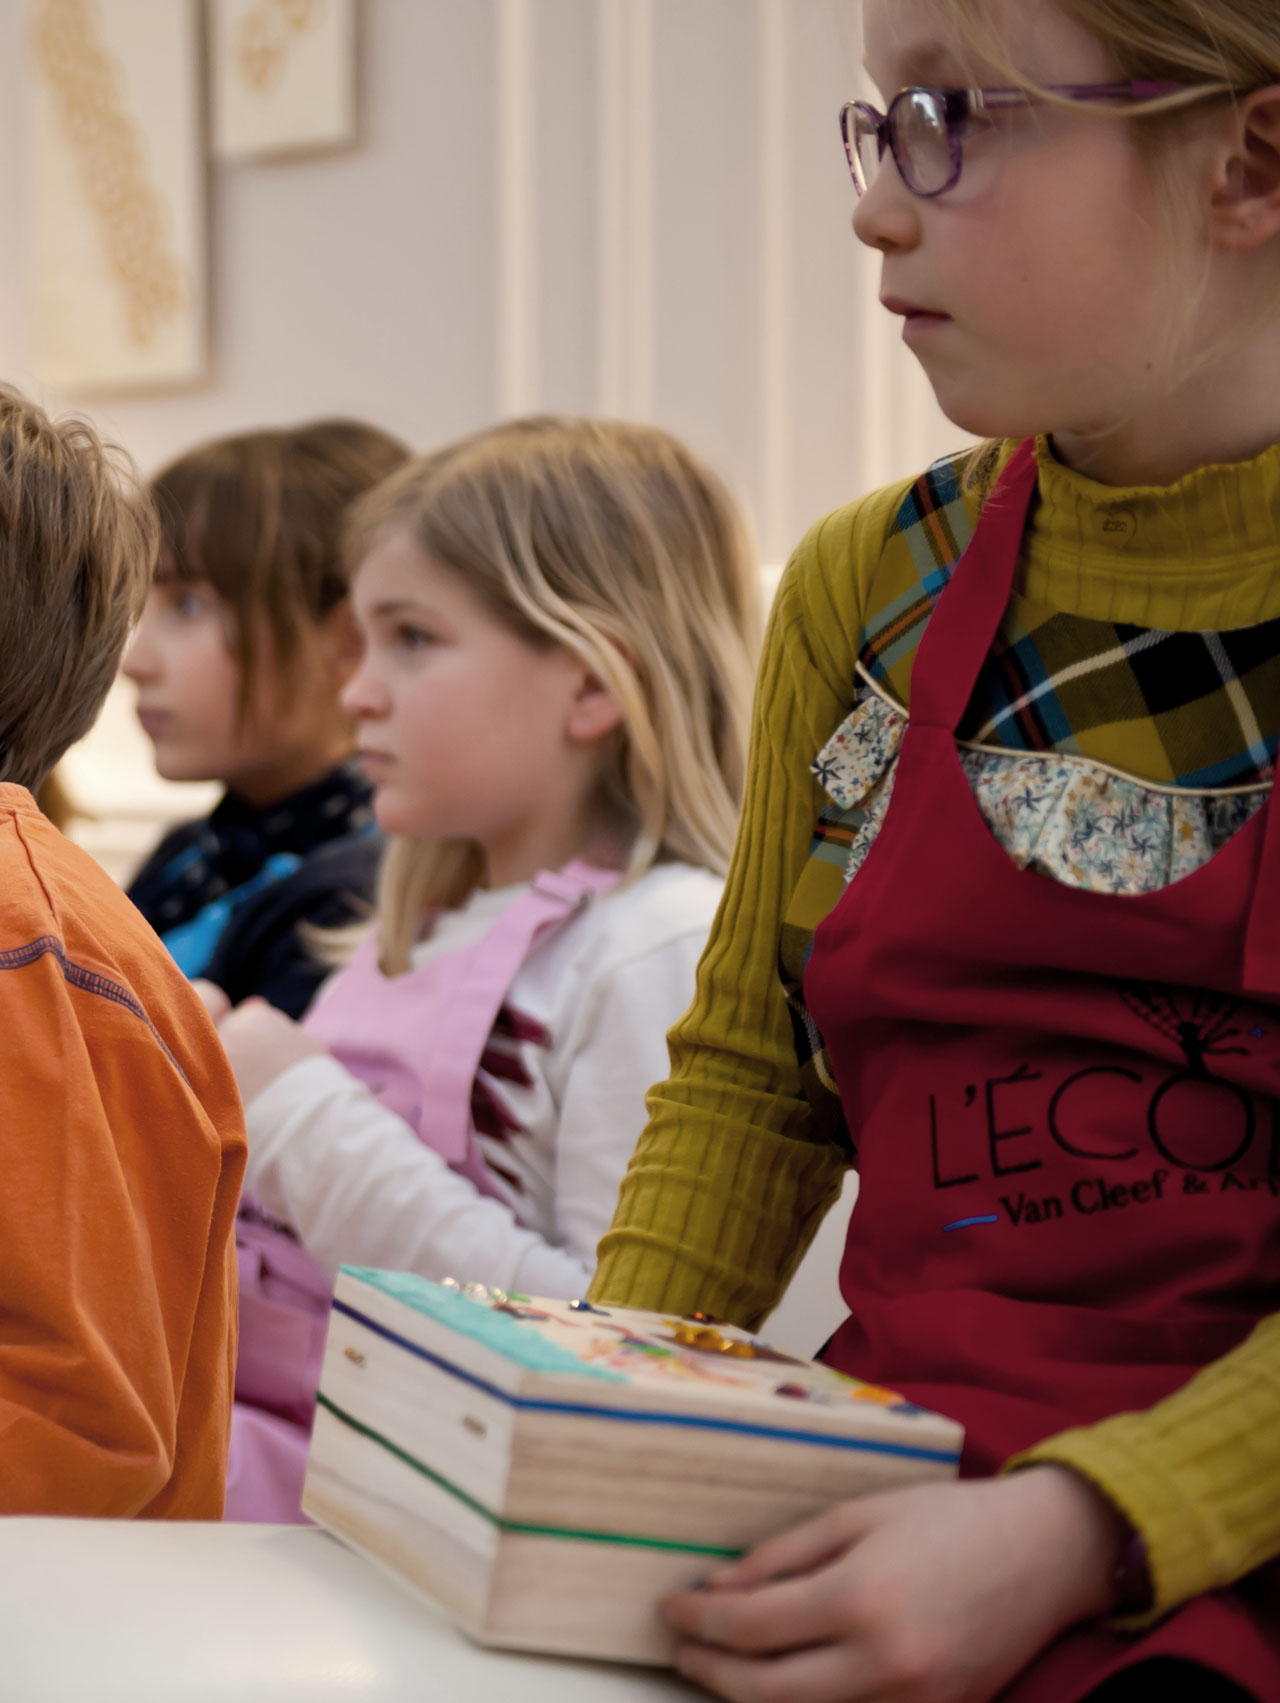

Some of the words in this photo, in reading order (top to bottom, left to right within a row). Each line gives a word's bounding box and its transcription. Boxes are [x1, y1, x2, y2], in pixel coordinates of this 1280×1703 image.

[930, 1063, 1280, 1190] L'ÉCO
[999, 1192, 1064, 1226] Van
[1070, 1168, 1170, 1215] Cleef
[1181, 1172, 1211, 1196] &
